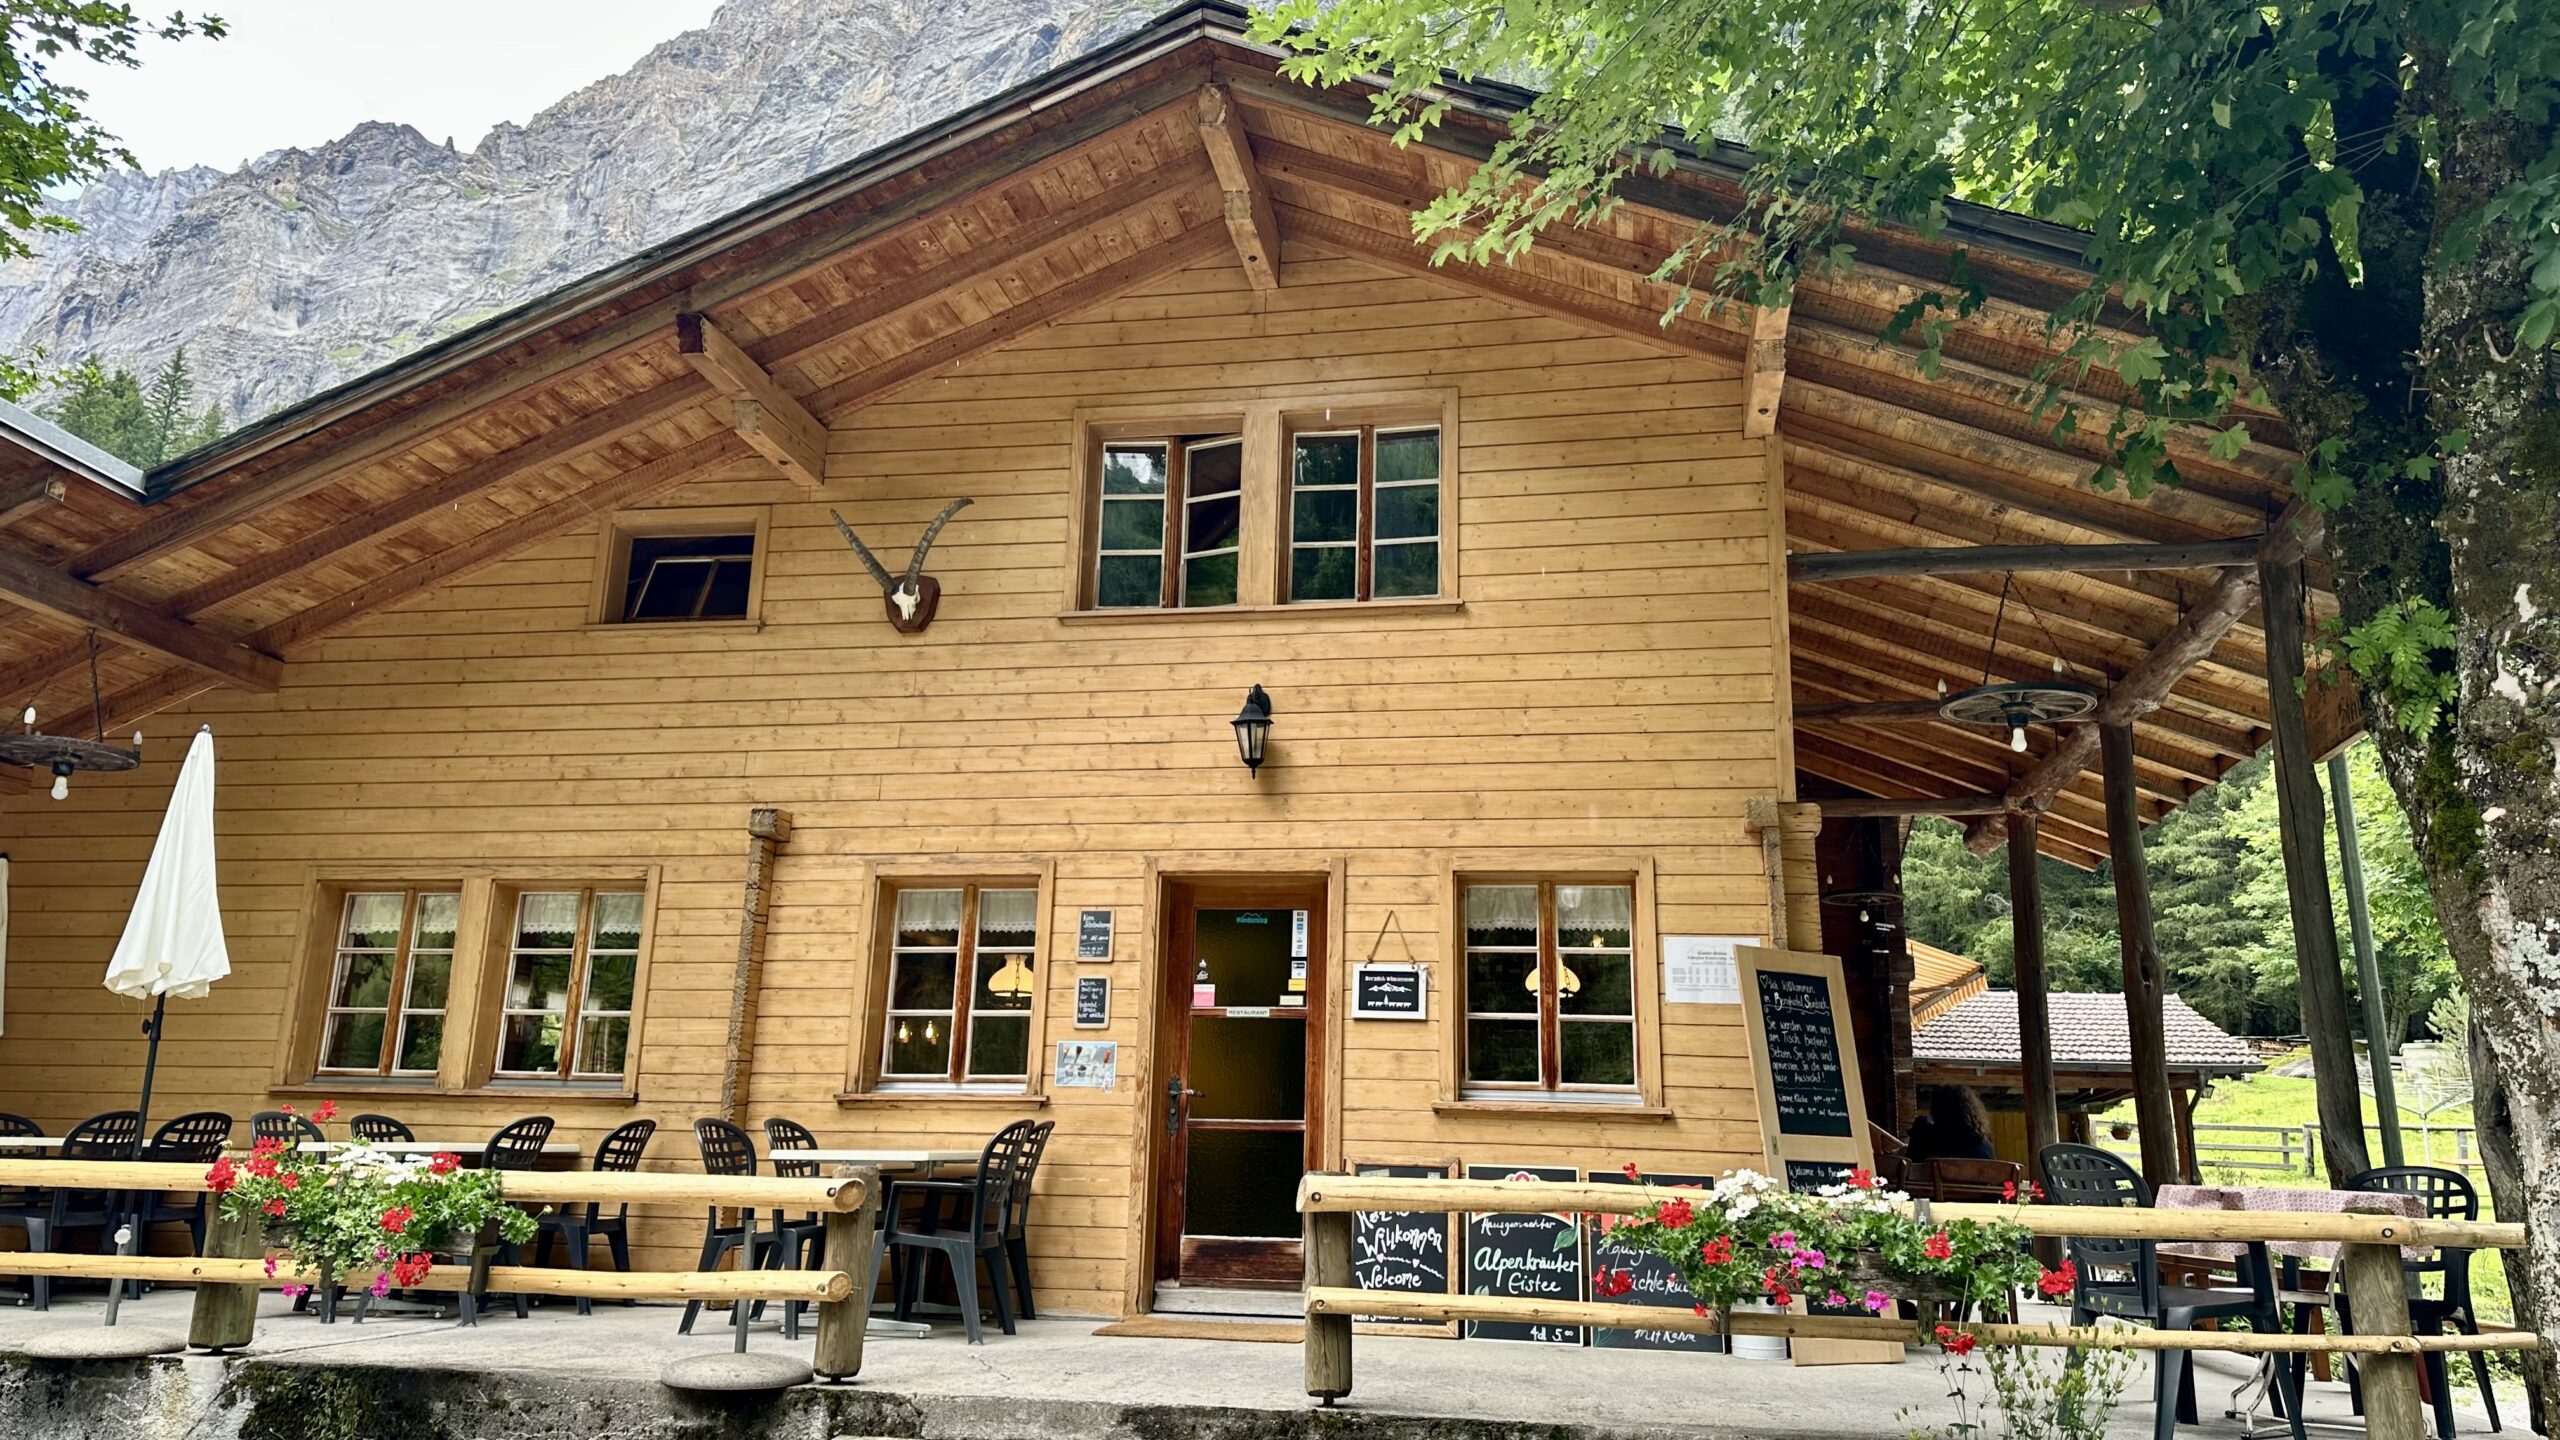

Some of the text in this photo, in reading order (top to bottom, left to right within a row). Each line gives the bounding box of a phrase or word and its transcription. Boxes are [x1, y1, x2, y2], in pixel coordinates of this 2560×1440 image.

[1781, 1030, 1801, 1045] Tisch
[1788, 1164, 1814, 1180] Welcome
[1817, 1165, 1825, 1178] to
[1357, 1224, 1443, 1257] Willkommen
[1355, 1264, 1422, 1290] Welcome
[1474, 1247, 1579, 1288] Alpenkräuter
[1508, 1272, 1562, 1295] Eistee
